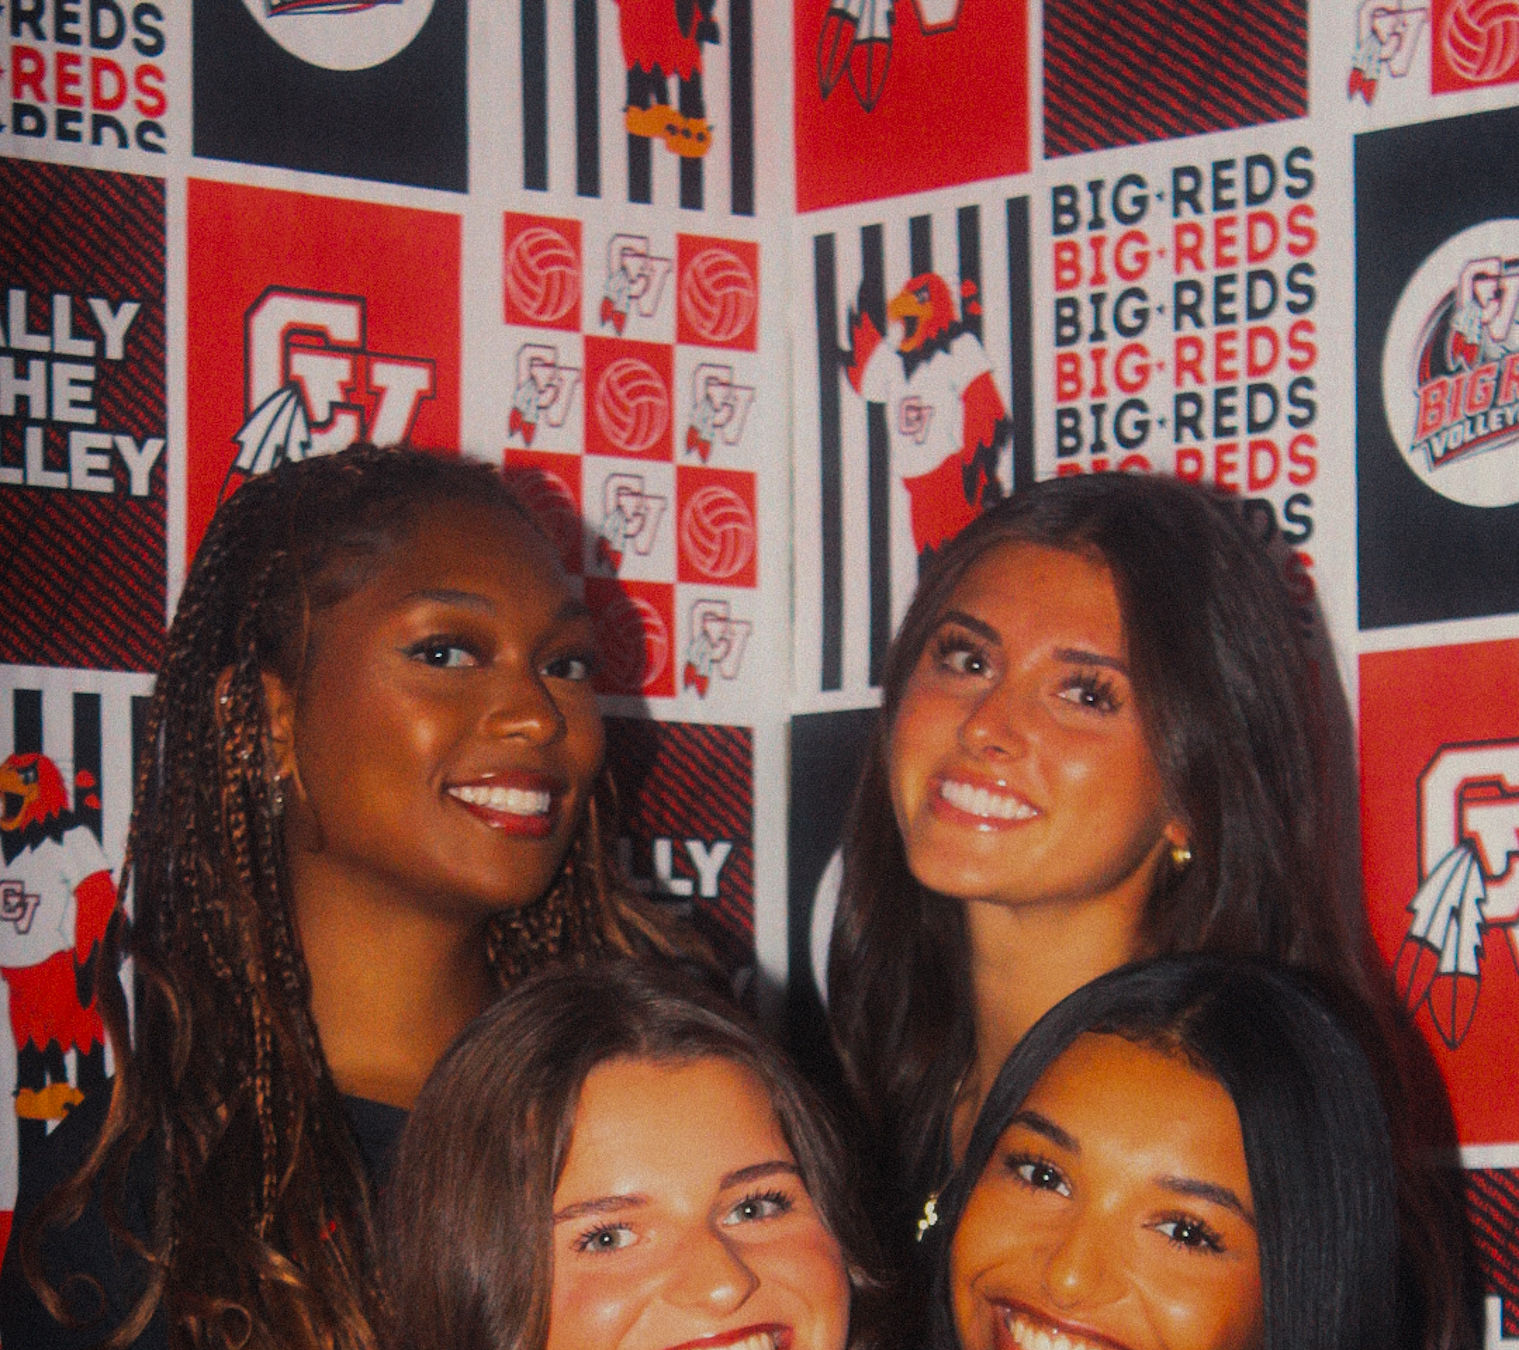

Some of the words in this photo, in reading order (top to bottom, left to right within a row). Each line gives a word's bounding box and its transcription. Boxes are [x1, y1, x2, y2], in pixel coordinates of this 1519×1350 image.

[10, 0, 165, 57] REDS
[11, 45, 168, 118] REDS
[1052, 173, 1149, 235] BIG
[1171, 146, 1316, 218] REDS
[1053, 230, 1151, 292] BIG
[1173, 204, 1318, 275] REDS
[0, 288, 141, 360] LLY
[1054, 286, 1150, 347] BIG
[1173, 262, 1317, 332] REDS
[0, 356, 97, 424] HE
[1055, 342, 1151, 402] BIG
[1173, 318, 1318, 388] REDS
[1056, 398, 1151, 458] BIG
[1174, 376, 1318, 444] REDS
